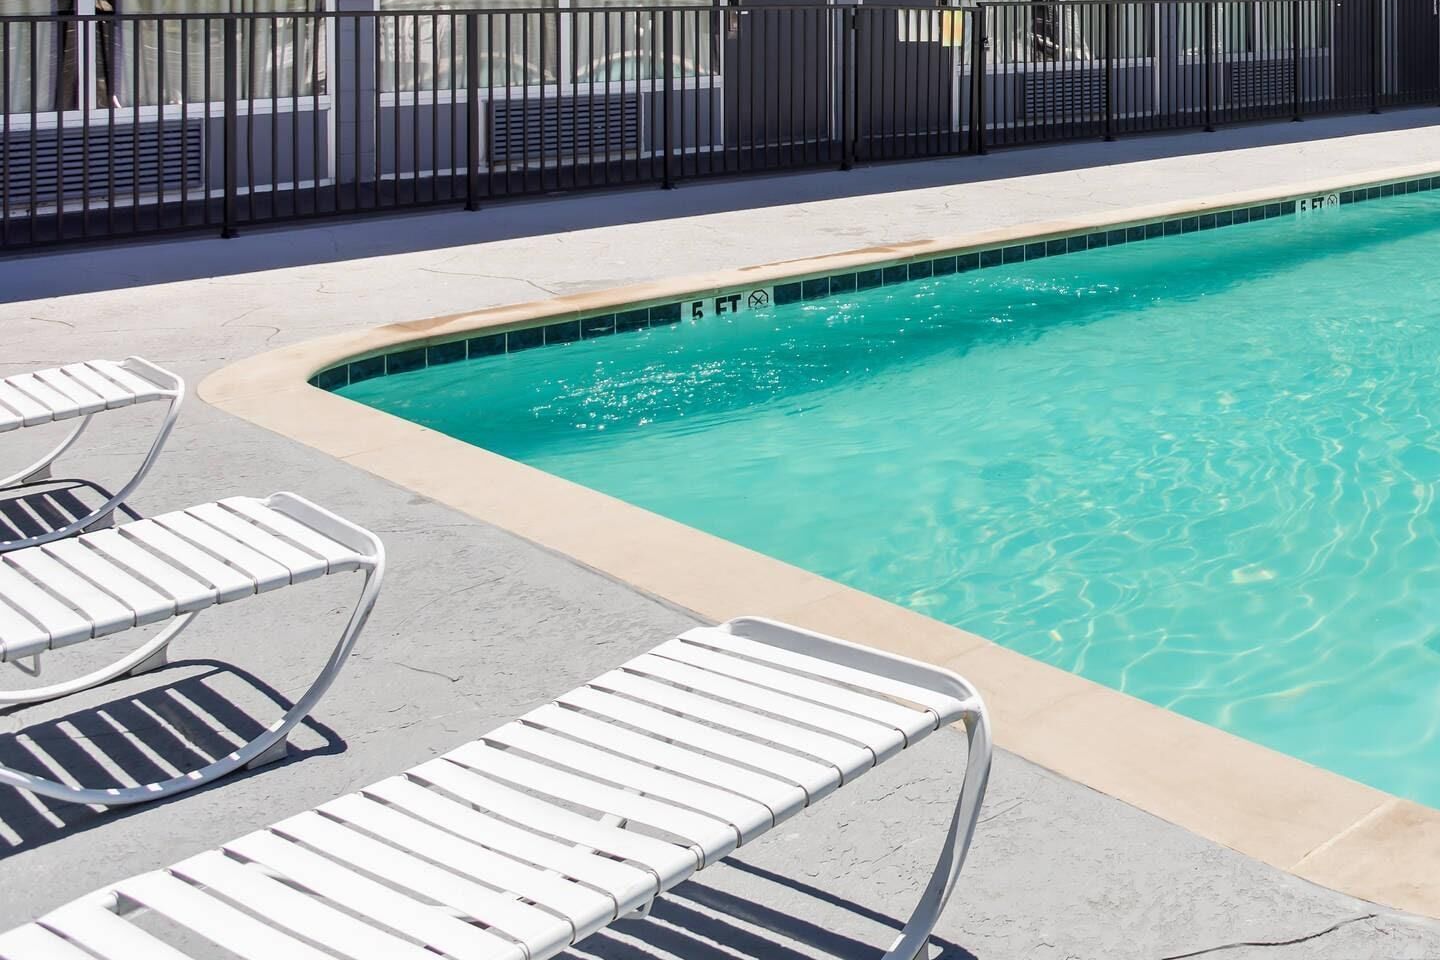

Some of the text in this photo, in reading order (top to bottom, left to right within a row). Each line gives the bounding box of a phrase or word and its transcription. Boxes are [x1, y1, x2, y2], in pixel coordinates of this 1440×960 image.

[1312, 196, 1324, 209] FT
[692, 294, 741, 320] 5 FT
